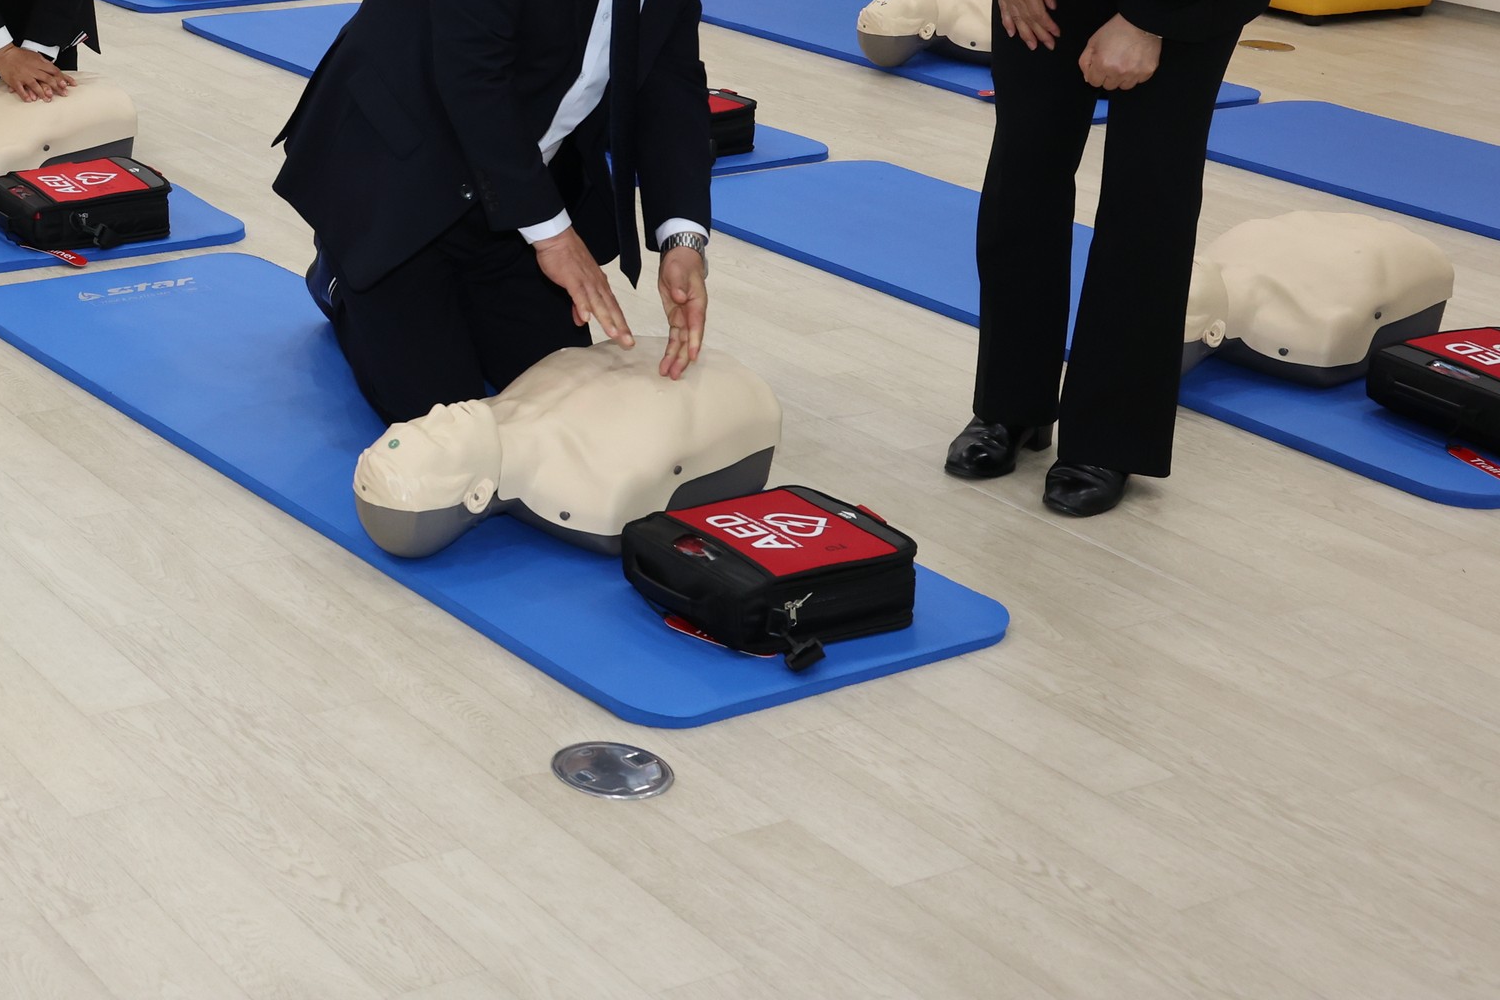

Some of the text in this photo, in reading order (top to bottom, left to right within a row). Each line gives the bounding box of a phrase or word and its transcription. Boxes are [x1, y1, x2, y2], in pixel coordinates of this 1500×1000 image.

[38, 175, 82, 193] AED
[1445, 344, 1500, 365] ED
[706, 514, 796, 548] AED
